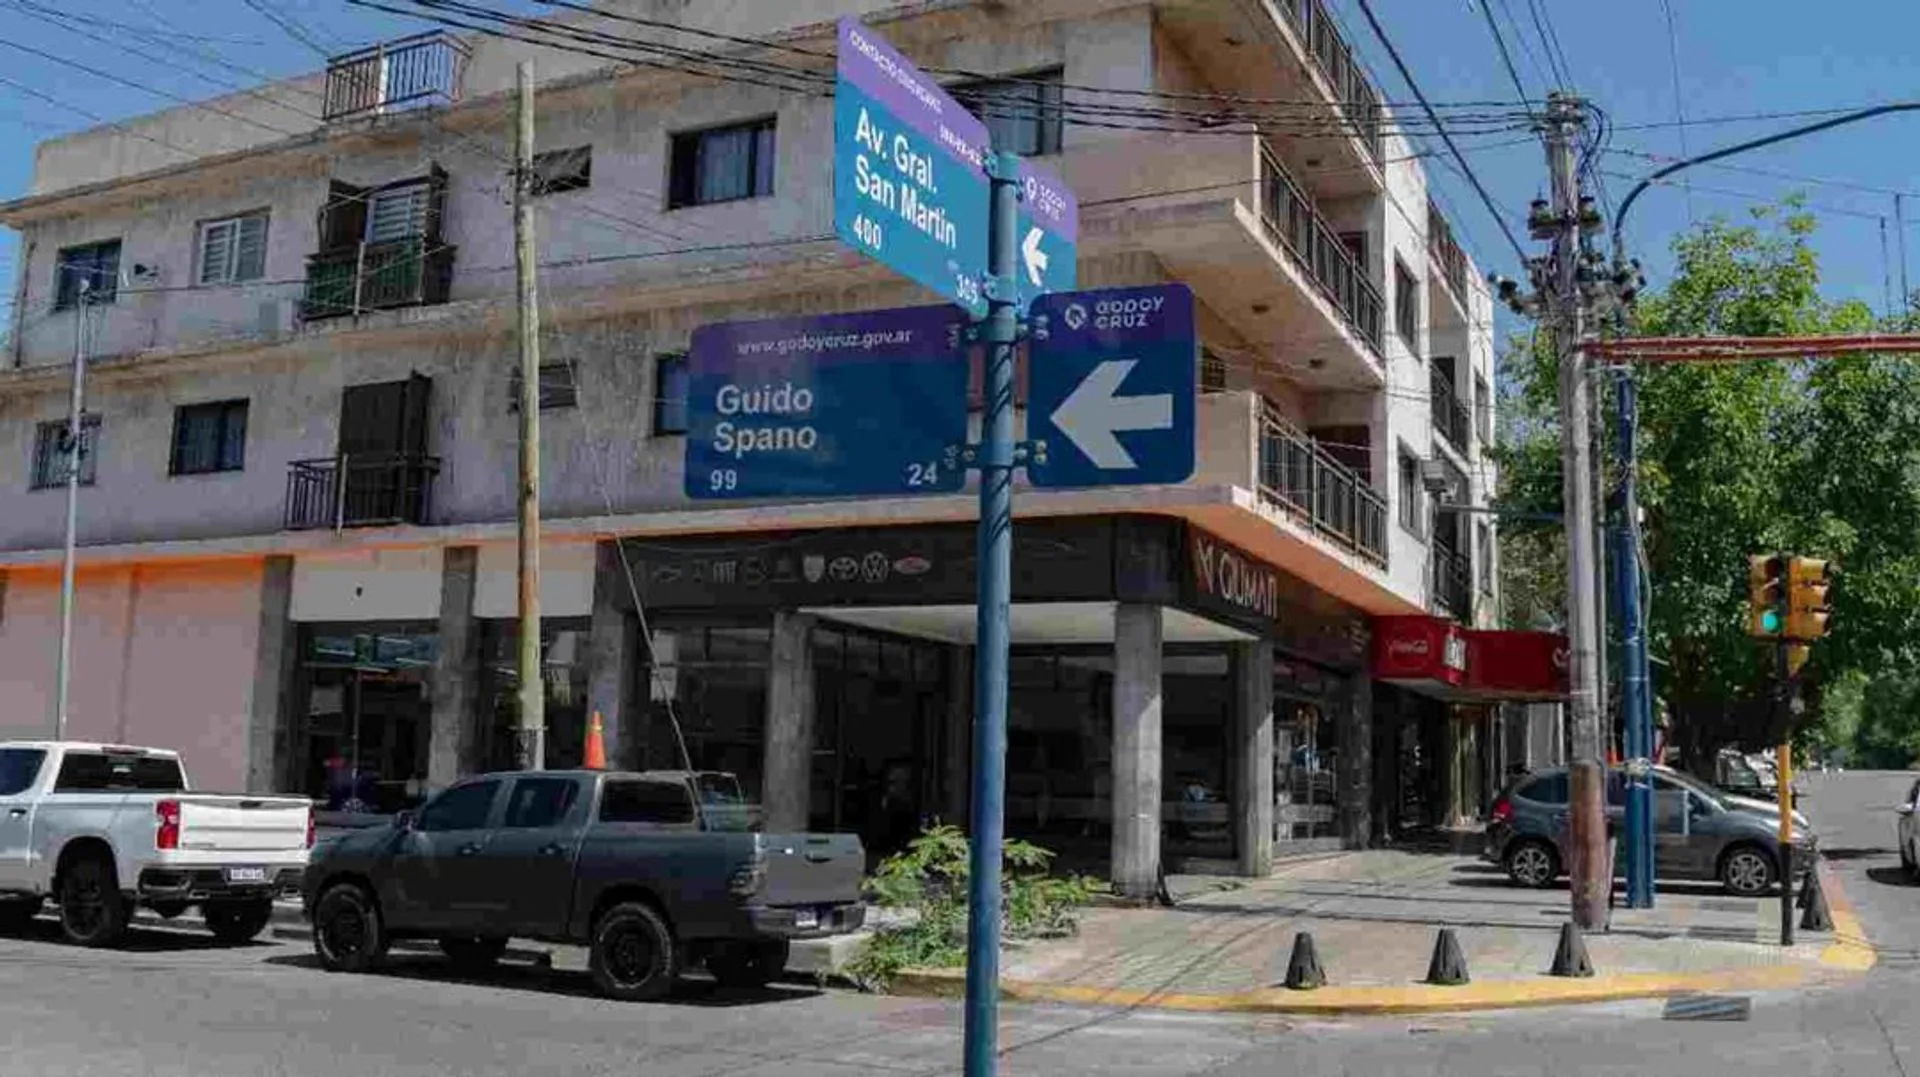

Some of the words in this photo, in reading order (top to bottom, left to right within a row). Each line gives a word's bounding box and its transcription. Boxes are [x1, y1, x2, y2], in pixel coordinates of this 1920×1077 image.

[855, 106, 887, 160] Av.
[894, 134, 938, 194] Gral.
[855, 154, 895, 211] San
[853, 213, 882, 251] 400
[1096, 296, 1165, 314] GODOY
[1095, 313, 1148, 329] CRUZ
[737, 329, 913, 356] www.godoycruz.gov.ar
[716, 382, 814, 415] Guido
[713, 421, 817, 459] Spano
[710, 468, 738, 491] 99
[907, 461, 938, 487] 24
